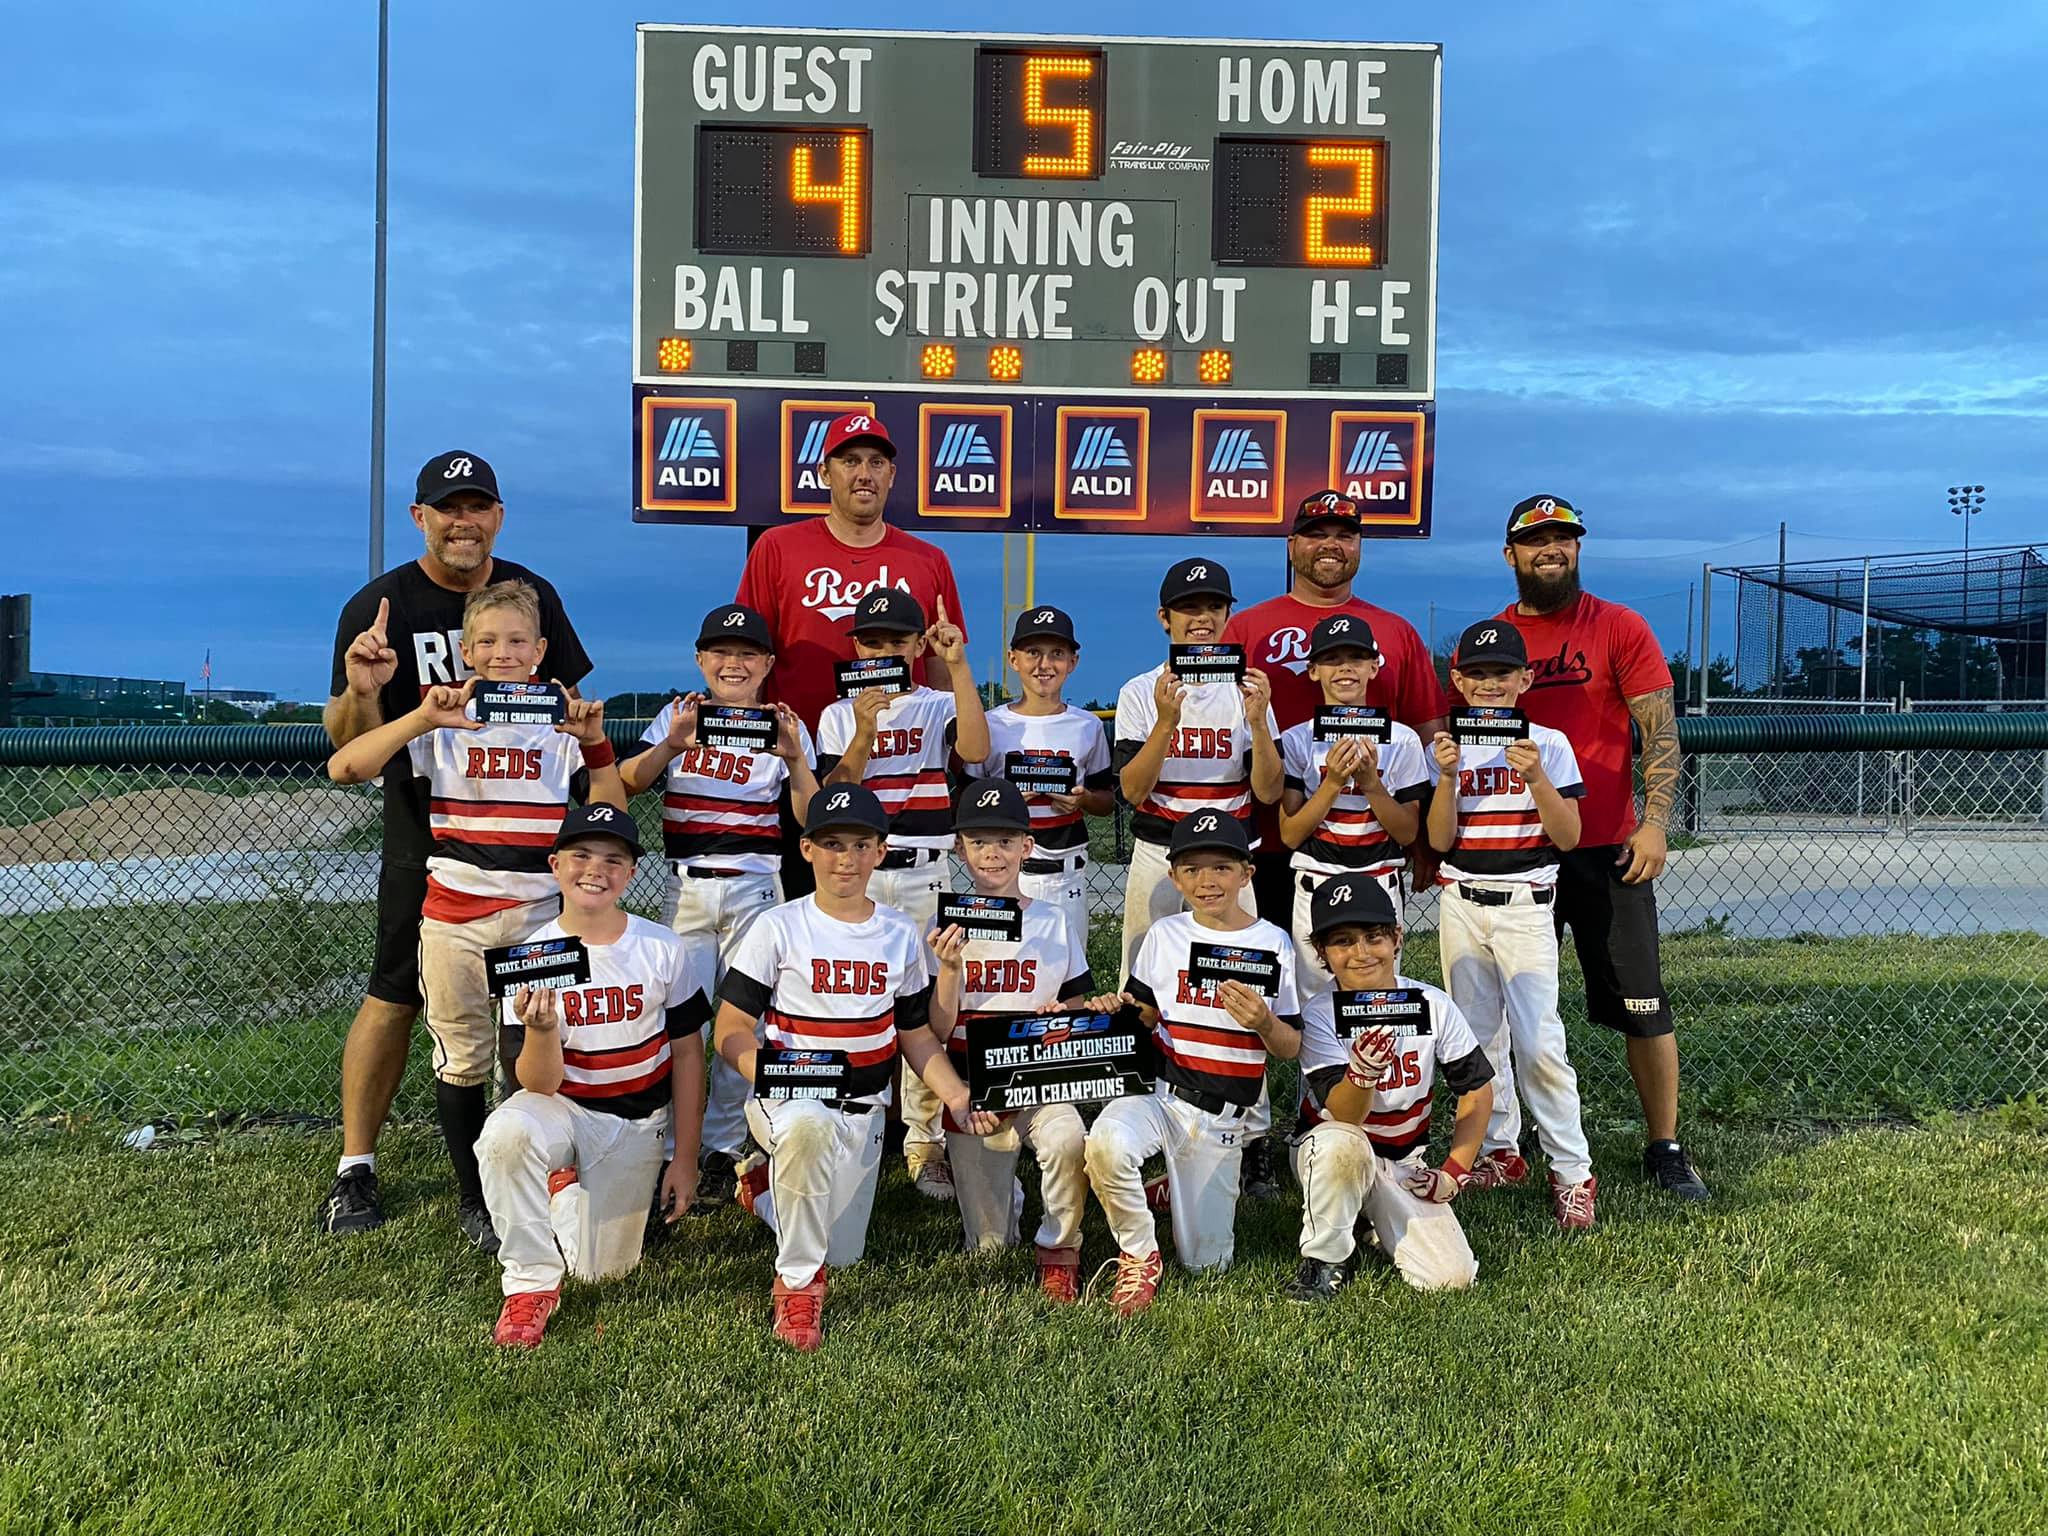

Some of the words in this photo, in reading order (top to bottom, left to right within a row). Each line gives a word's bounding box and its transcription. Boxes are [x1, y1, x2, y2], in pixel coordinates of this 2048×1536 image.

[693, 43, 872, 113] GUEST
[1217, 57, 1387, 125] HOME
[1024, 57, 1092, 173] 5
[1110, 141, 1193, 159] Fair-Play
[1110, 160, 1117, 169] A
[1168, 161, 1210, 171] COMPANY
[792, 135, 859, 251] 4
[1306, 146, 1374, 263] 2
[930, 198, 1134, 268] INNING
[674, 265, 809, 334] BALL
[874, 269, 1074, 340] STRIKE
[1133, 277, 1246, 344] OUT
[1310, 280, 1411, 346] H-E
[658, 466, 720, 488] ALDI
[797, 470, 831, 489] AL
[934, 473, 995, 493] ALDI
[1071, 475, 1131, 496] ALDI
[1207, 479, 1267, 499] ALDI
[1345, 480, 1406, 501] ALDI
[413, 629, 475, 685] RE
[1176, 655, 1195, 664] STATE
[1196, 655, 1240, 664] CHAMPIONSHIP
[1528, 640, 1592, 687] eds
[841, 672, 860, 681] STATE
[860, 667, 903, 679] CHAMPIONSHIP
[1182, 672, 1198, 682] 2021
[1200, 672, 1235, 682] CHAMPIONS
[484, 693, 506, 703] STATE
[507, 694, 558, 705] CHAMPIONSHIP
[489, 711, 508, 722] 2021
[510, 712, 552, 723] CHAMPIONS
[703, 717, 724, 727] STATE
[725, 719, 772, 730] CHAMPIONSHIP
[1320, 716, 1340, 725] STATE
[1340, 717, 1385, 727] CHAMPIONSHIP
[1456, 717, 1475, 727] STATE
[1477, 718, 1522, 728] CHAMPIONSHIP
[707, 735, 725, 745] 2021
[727, 736, 765, 748] CHAMPIONS
[1460, 735, 1477, 744] 2021
[1478, 735, 1516, 746] CHAMPIONS
[466, 747, 542, 780] REDS
[680, 748, 754, 786] REDS
[1011, 765, 1029, 775] STATE
[1029, 766, 1071, 776] CHAMPIONSHIP
[1032, 782, 1066, 793] CHAMPIONS
[1459, 766, 1526, 797] REDS
[944, 906, 965, 917] STATE
[966, 907, 1015, 921] CHAMPIONSHIP
[968, 927, 1008, 941] CHAMPIONS
[495, 960, 520, 974] STATE
[522, 951, 580, 969] CHAMPIONSHIP
[1197, 957, 1219, 968] STATE
[1220, 959, 1273, 975] CHAMPIONSHIP
[528, 973, 576, 992] CHAMPIONS
[810, 957, 889, 996] REDS
[965, 959, 1037, 993] REDS
[561, 983, 644, 1027] REDS
[1342, 1005, 1366, 1016] STATE
[1367, 1003, 1421, 1014] CHAMPIONSHIP
[985, 1045, 1029, 1066] STATE
[1033, 1035, 1136, 1062] CHAMPIONSHIP
[763, 1064, 788, 1074] STATE
[789, 1064, 844, 1075] CHAMPIONSHIP
[769, 1087, 790, 1098] 2021
[792, 1087, 838, 1099] CHAMPIONS
[1004, 1086, 1038, 1108] 2021
[1041, 1077, 1124, 1104] CHAMPIONS
